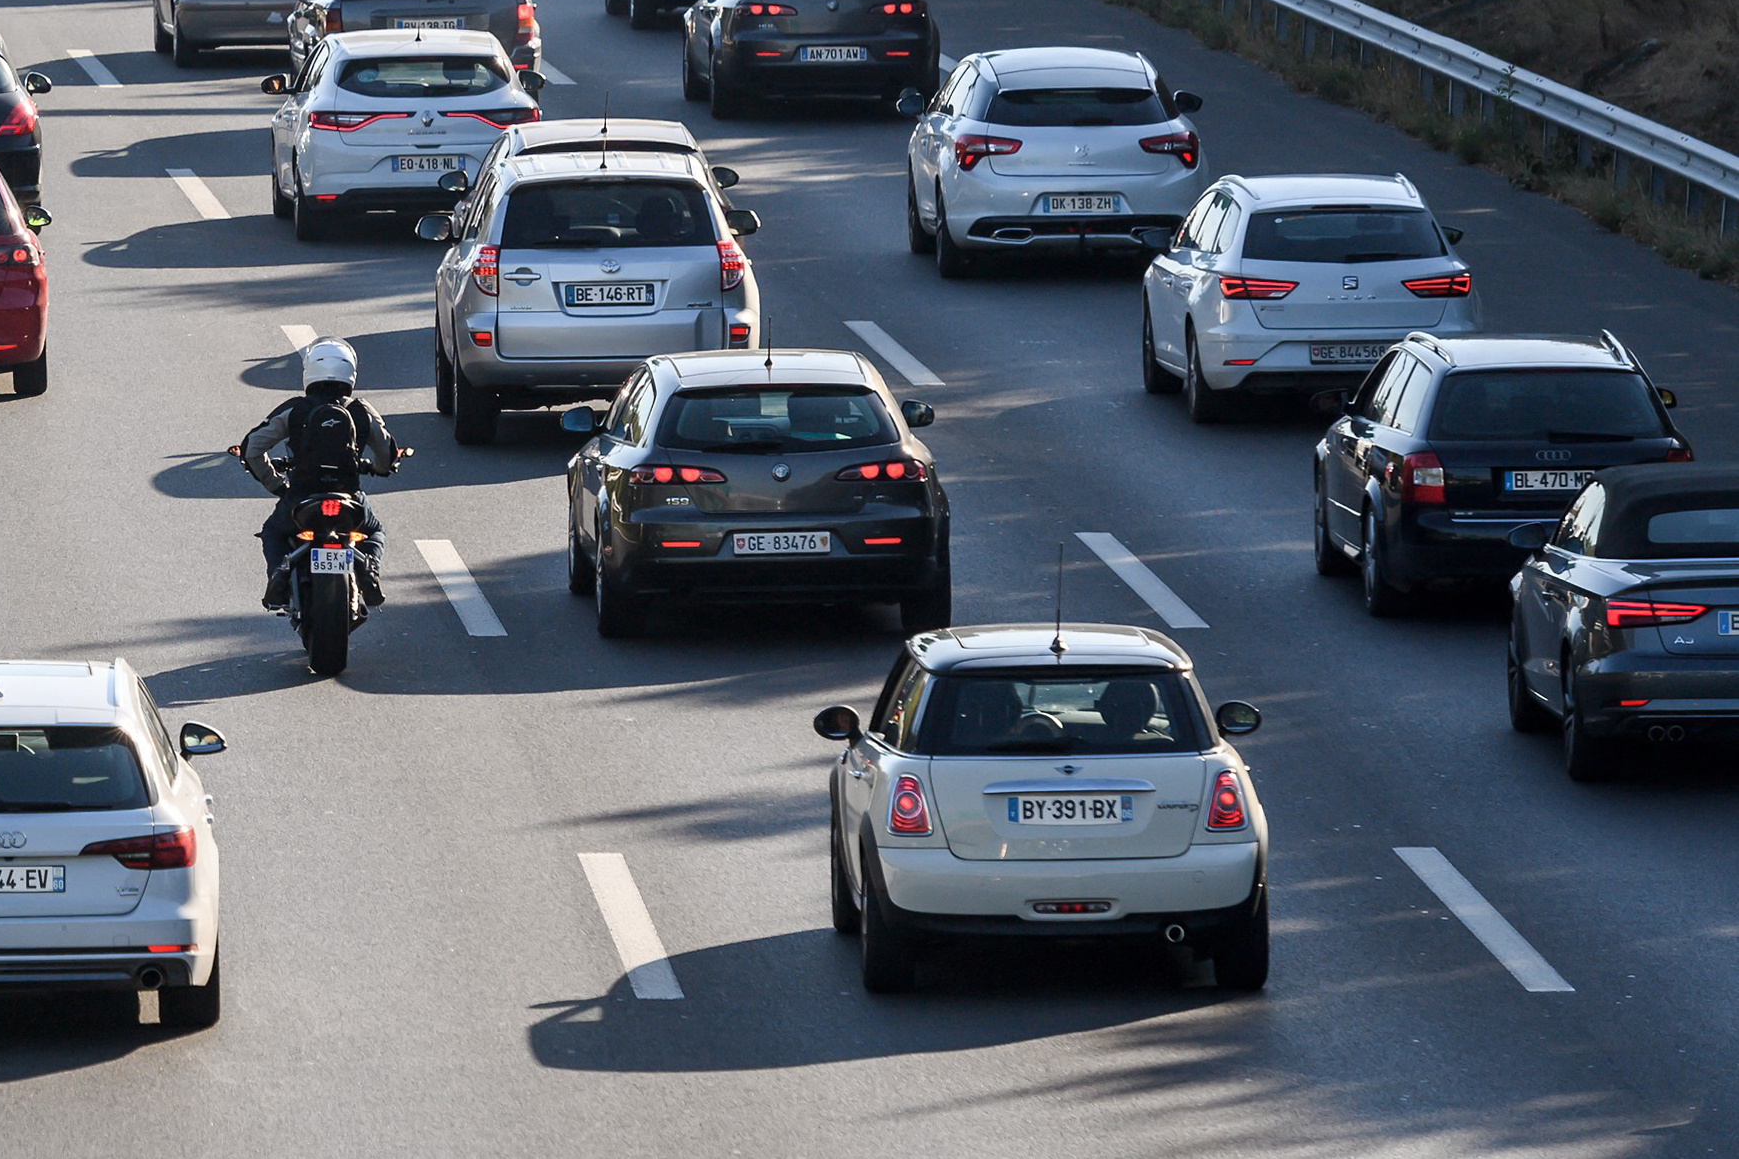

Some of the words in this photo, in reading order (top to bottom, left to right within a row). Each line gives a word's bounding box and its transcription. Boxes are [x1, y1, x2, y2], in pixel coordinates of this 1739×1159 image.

[400, 158, 457, 171] EQ-418-NL
[1051, 197, 1112, 210] DK-138-ZH
[575, 286, 644, 302] BE-146-RT
[1022, 799, 1118, 821] BY-391-BX
